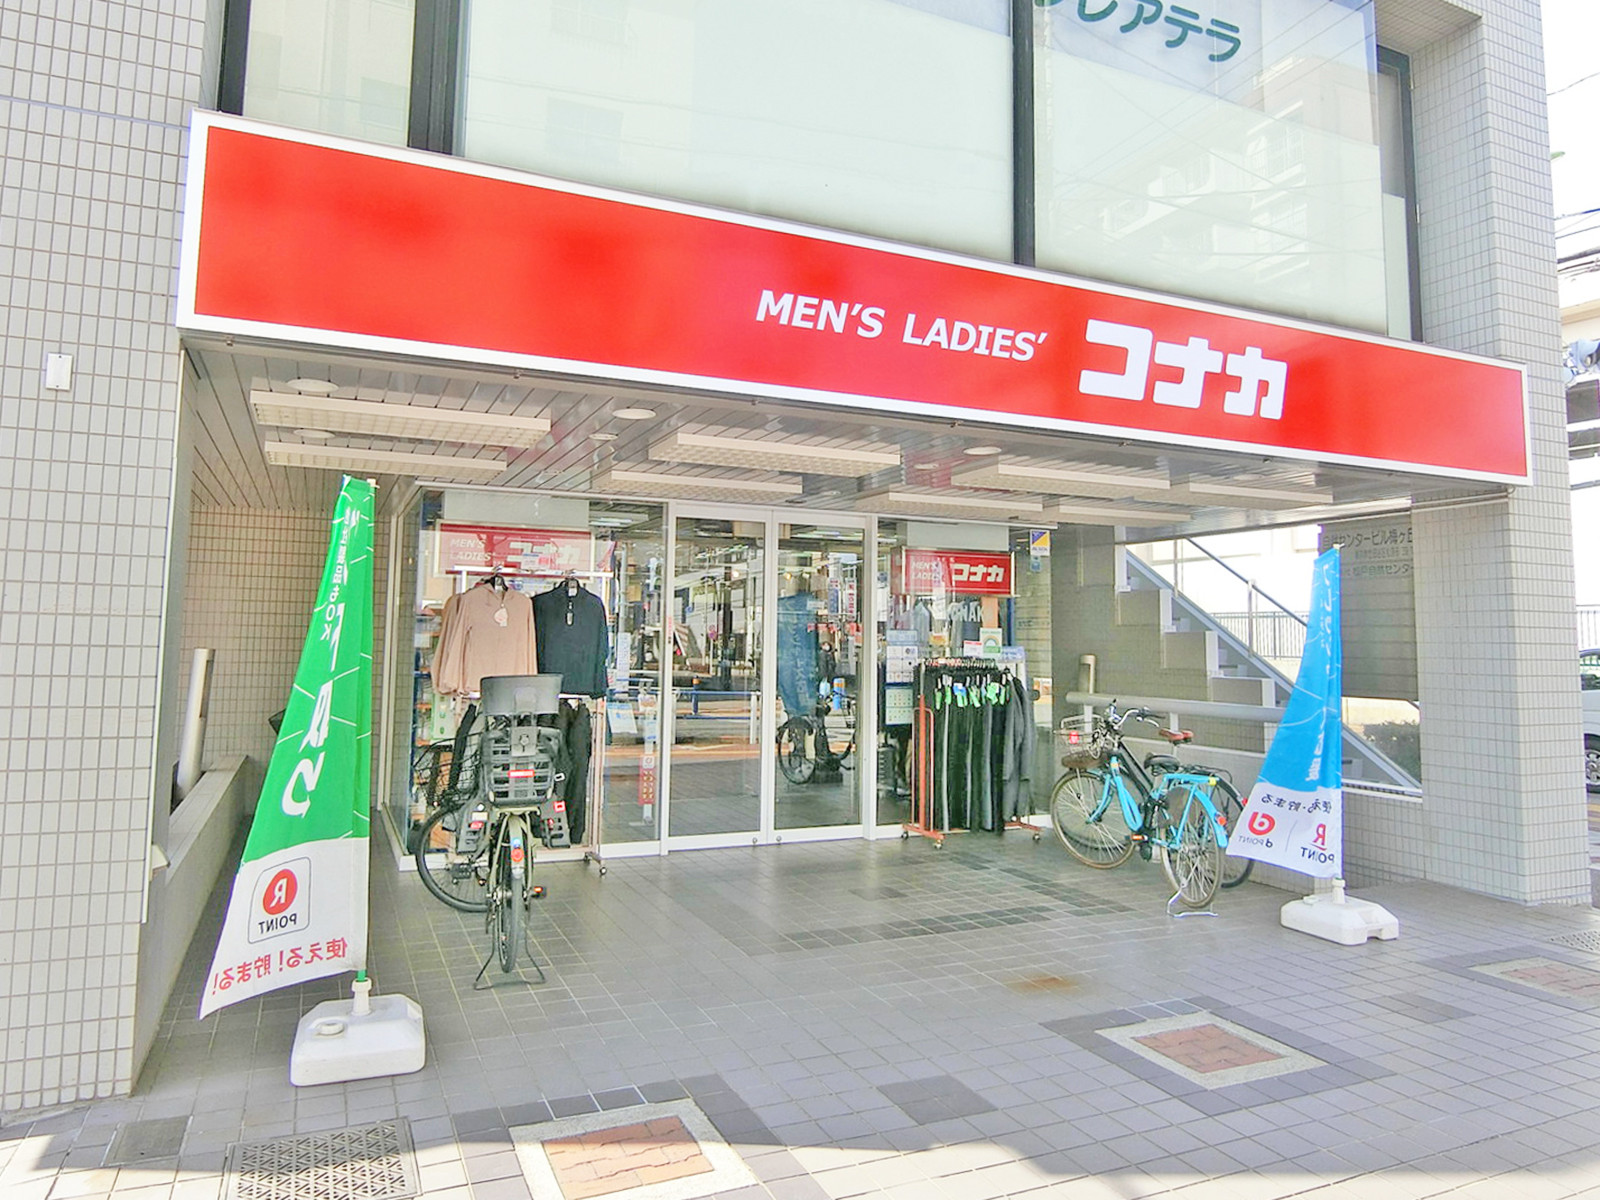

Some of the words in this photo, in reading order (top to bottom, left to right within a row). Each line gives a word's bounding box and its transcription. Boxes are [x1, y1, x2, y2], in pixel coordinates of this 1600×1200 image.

[1035, 0, 1241, 62] レアテラ
[756, 289, 885, 339] MEN'S
[903, 314, 1048, 362] LADIES'
[1079, 318, 1289, 420] コナカ
[507, 541, 581, 565] コナカ
[951, 563, 1005, 582] コナカ
